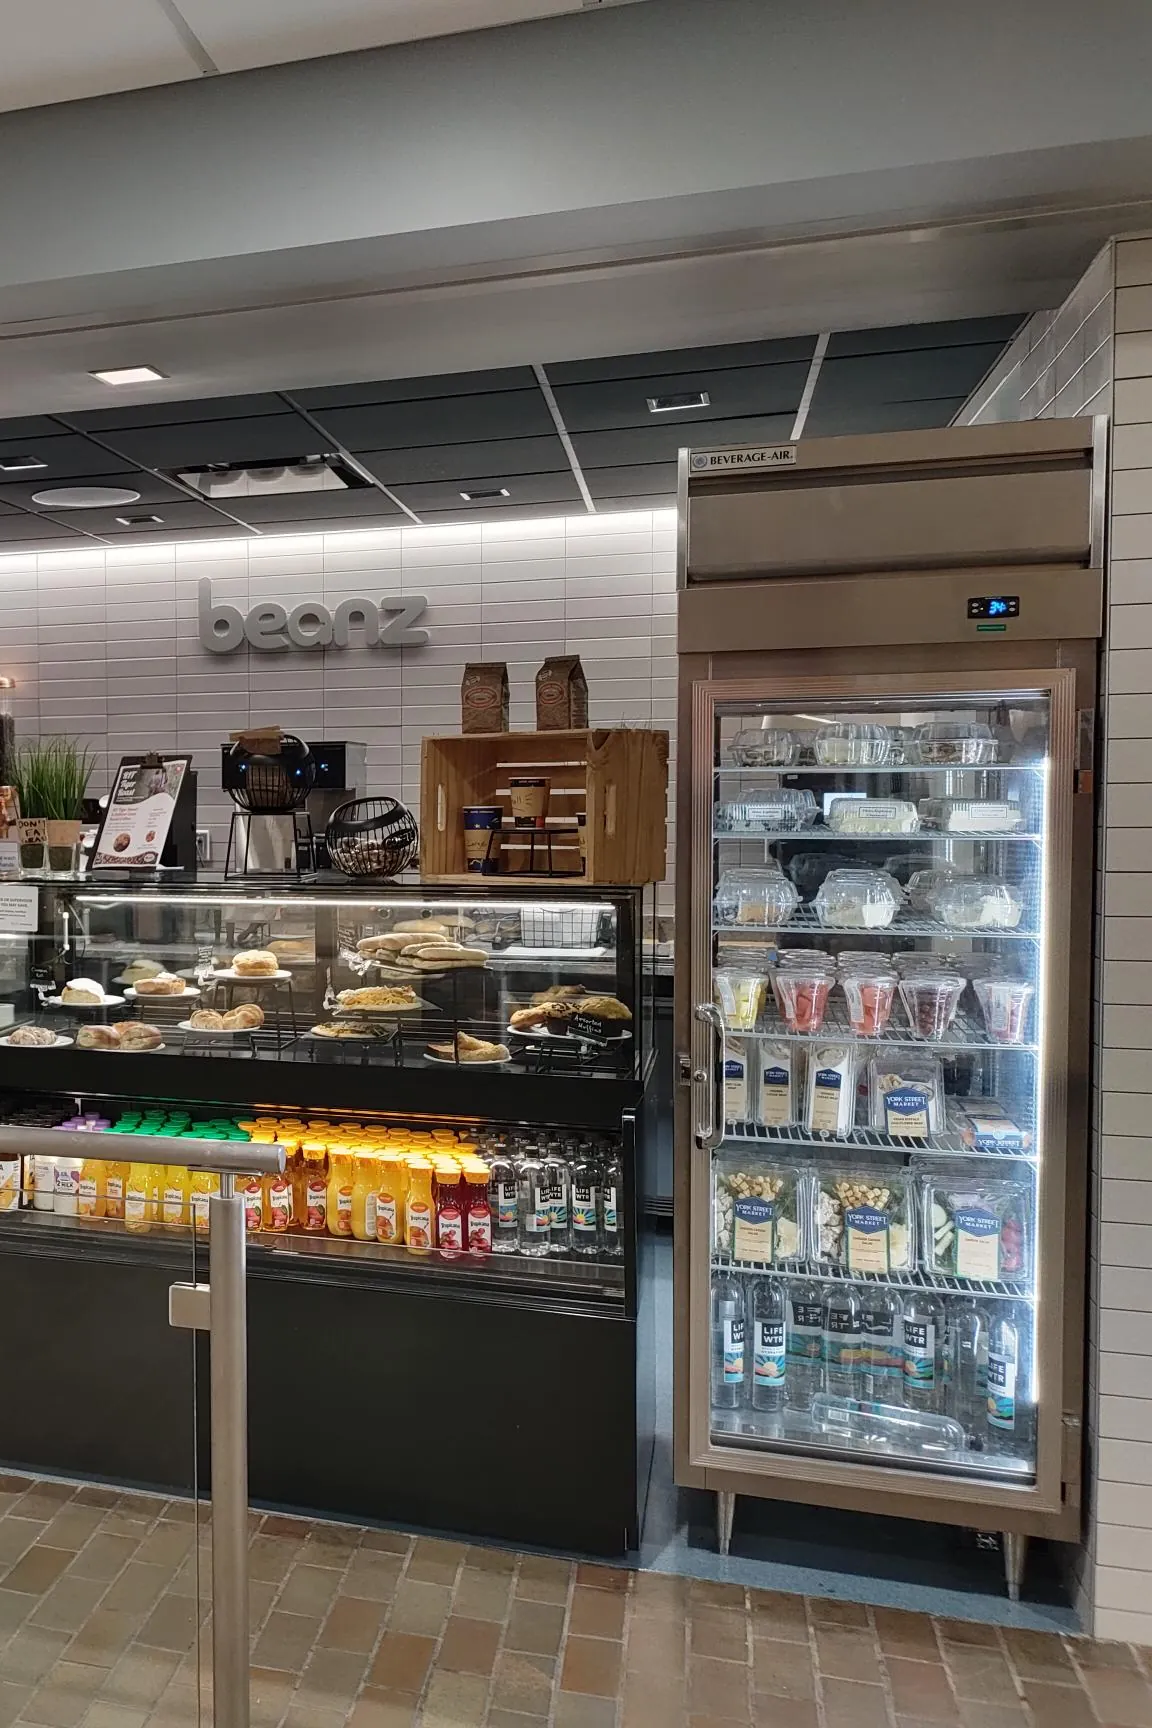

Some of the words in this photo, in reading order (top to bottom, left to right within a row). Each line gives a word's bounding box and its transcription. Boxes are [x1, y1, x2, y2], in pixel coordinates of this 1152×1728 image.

[198, 577, 430, 652] beanz
[886, 1096, 903, 1105] YORK
[904, 1096, 926, 1105] STREET
[736, 1203, 751, 1213] YORK
[752, 1205, 772, 1215] STREET
[848, 1214, 865, 1222] YORK
[866, 1215, 886, 1225] STREET
[978, 1218, 999, 1228] STREET
[905, 1325, 925, 1335] LIFE
